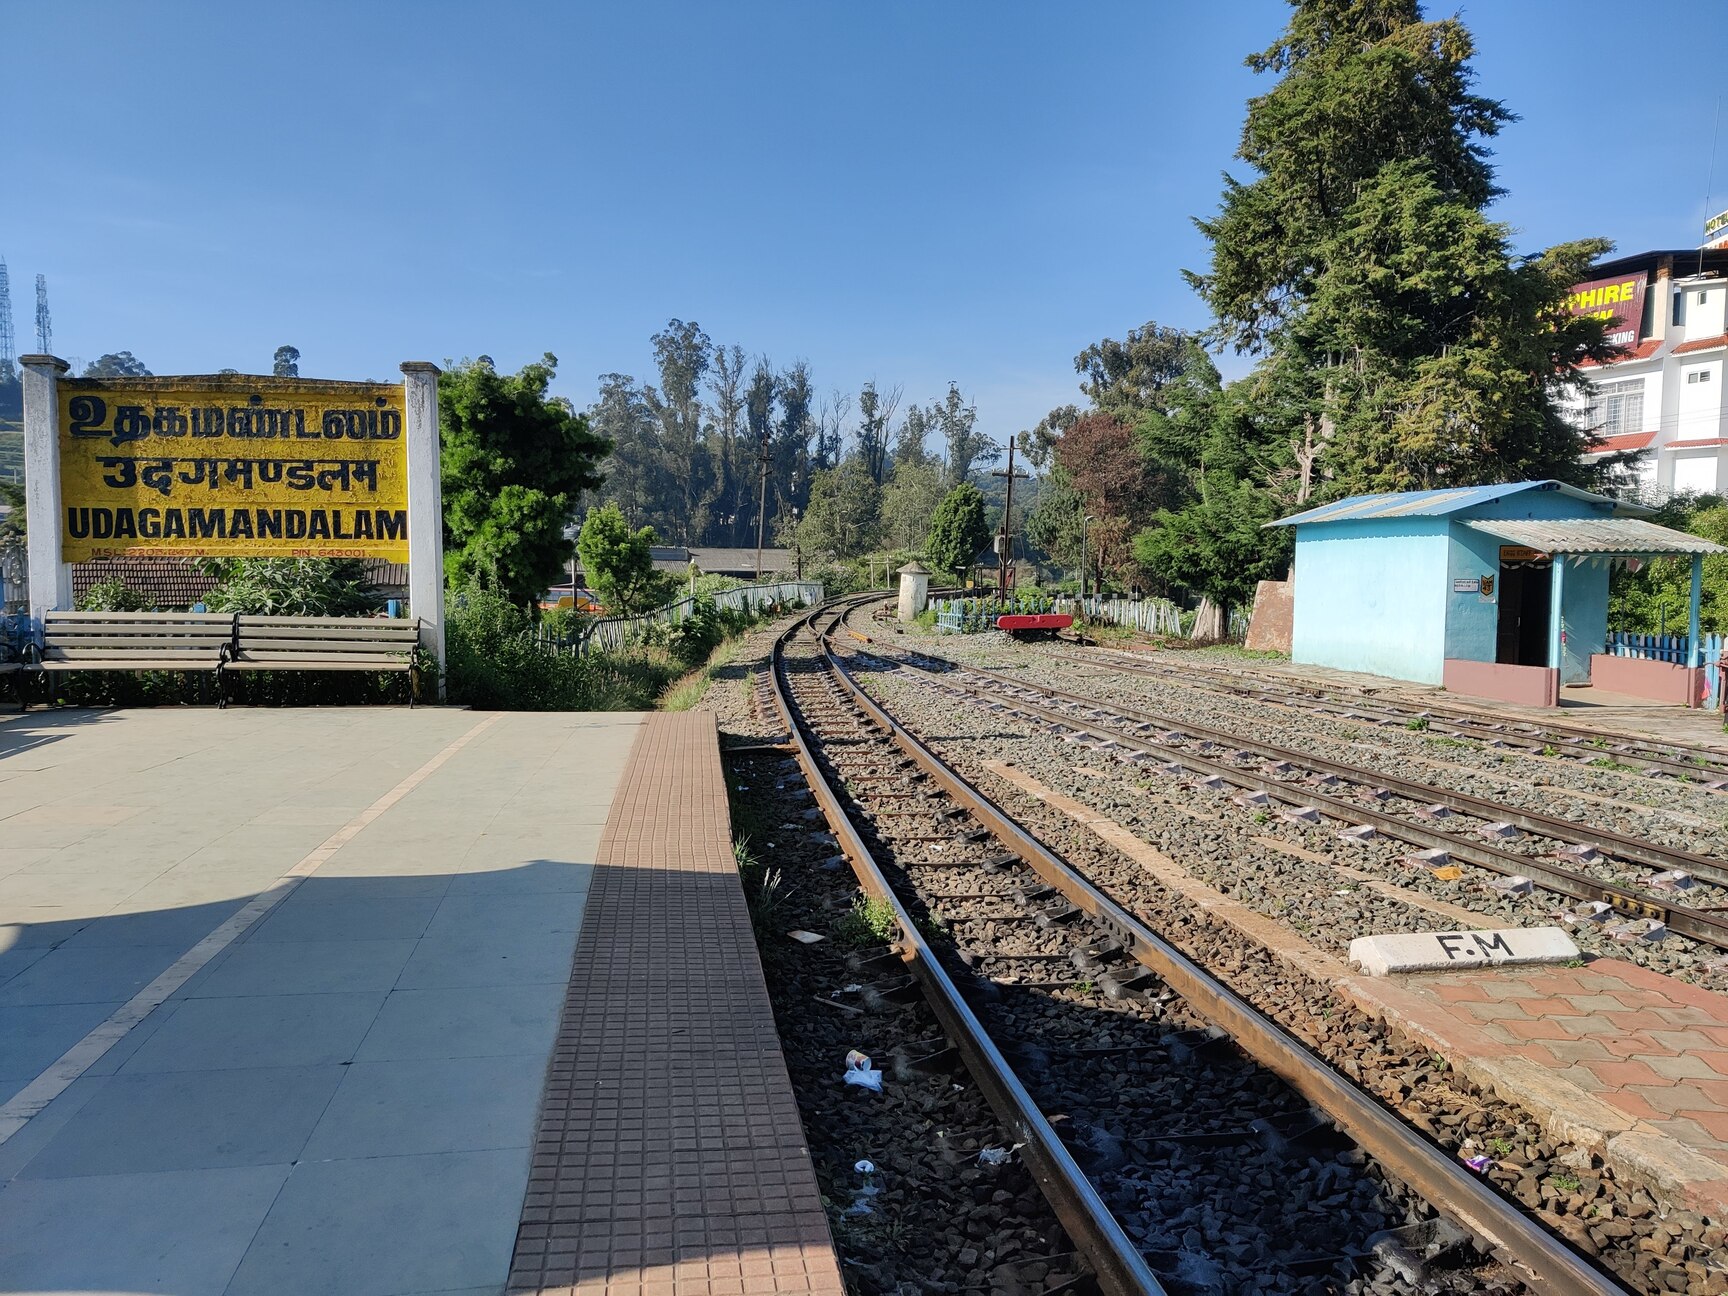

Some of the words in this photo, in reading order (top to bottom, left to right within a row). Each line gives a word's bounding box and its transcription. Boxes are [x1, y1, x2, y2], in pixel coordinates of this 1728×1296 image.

[68, 394, 402, 447] உதகமண்டலம்
[68, 508, 408, 542] UDAGAMANDALAM
[1436, 932, 1516, 961] F.M
